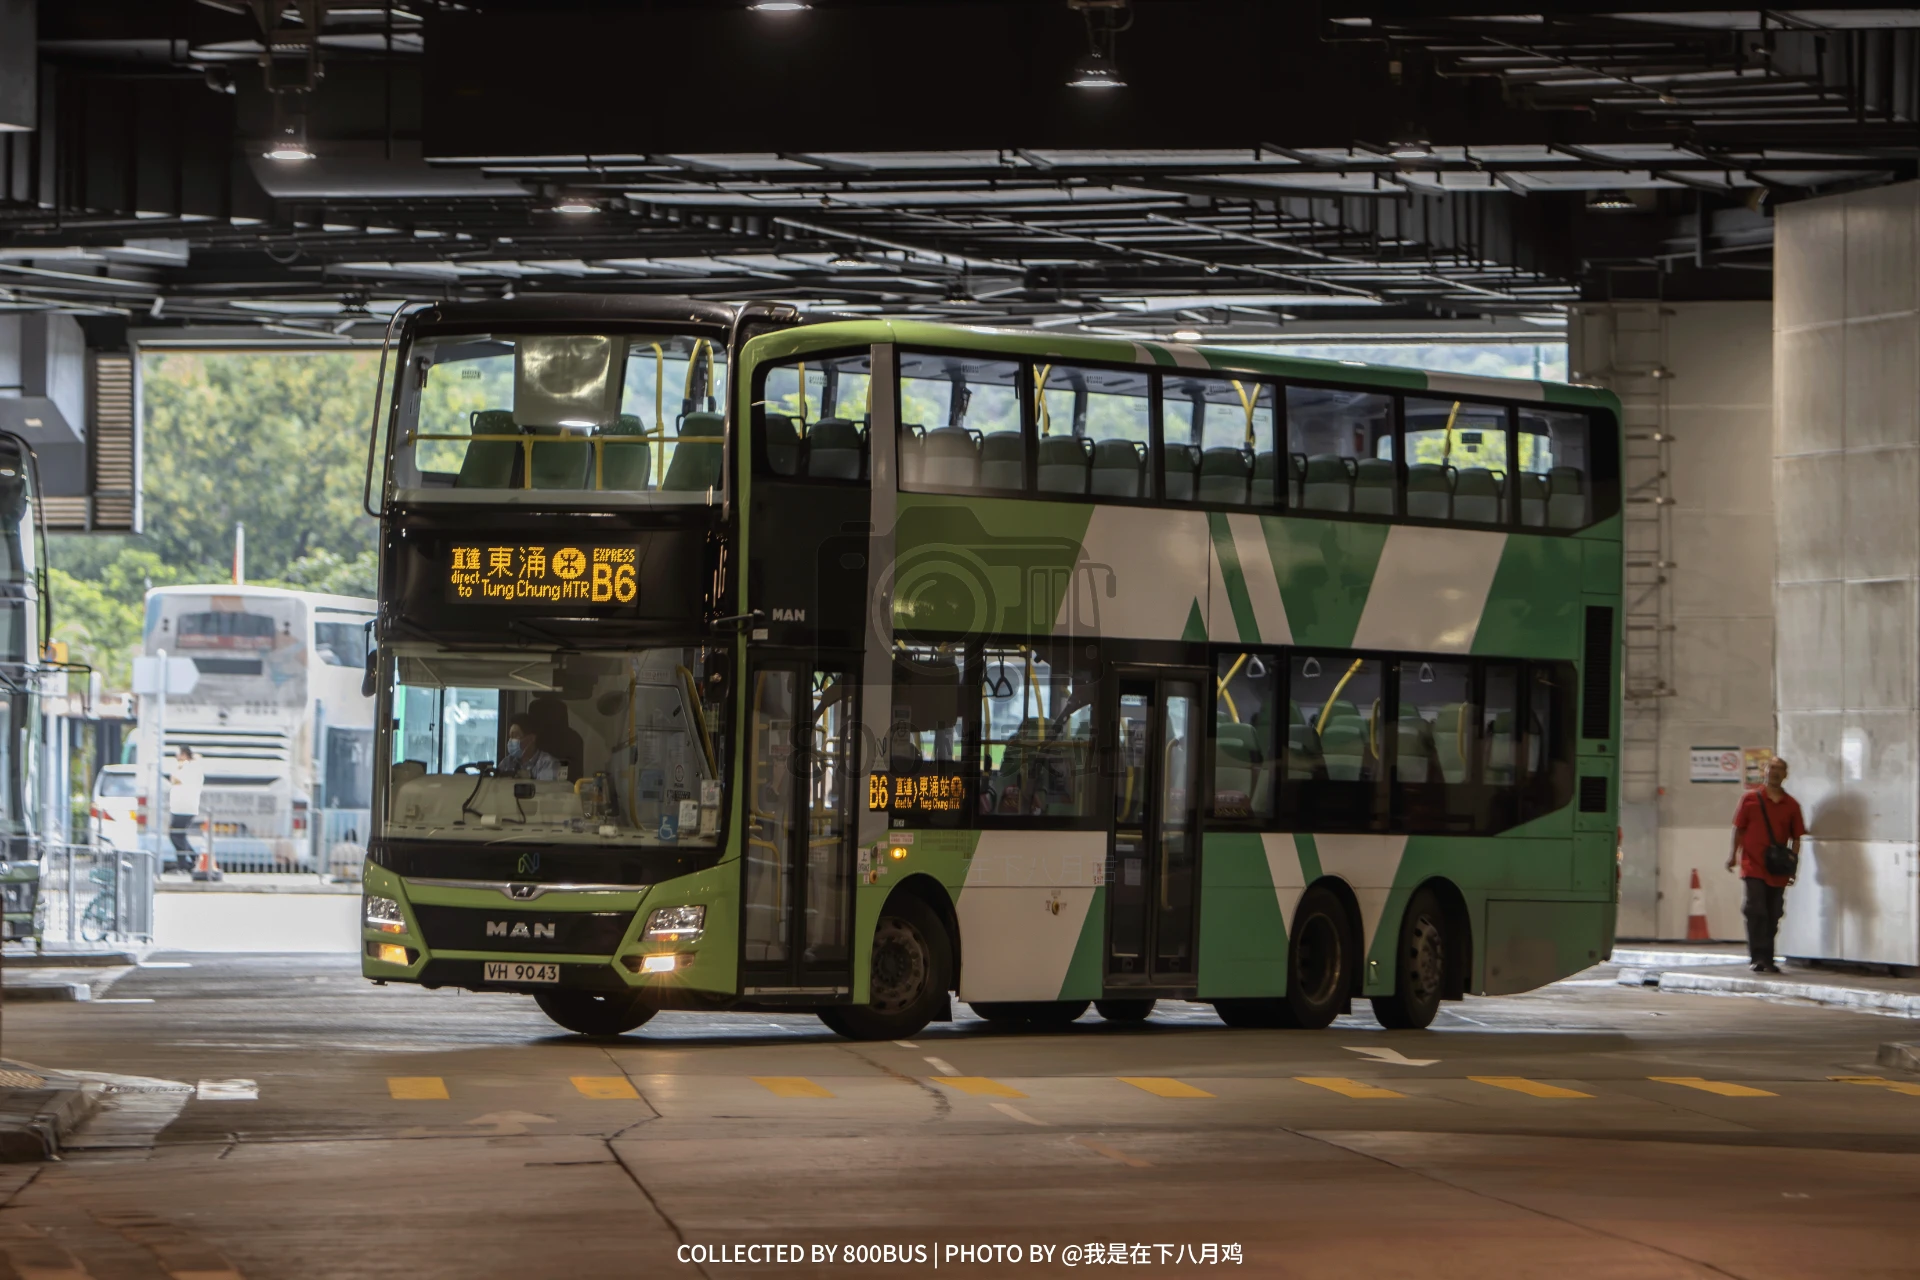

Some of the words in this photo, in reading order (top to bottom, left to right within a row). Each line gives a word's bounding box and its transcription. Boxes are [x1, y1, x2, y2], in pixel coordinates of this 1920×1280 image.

[451, 547, 481, 570] 直達
[486, 546, 546, 579] 東涌
[593, 548, 636, 563] EXPRESS
[451, 571, 480, 585] direct
[591, 563, 637, 602] B6
[458, 584, 473, 598] to
[481, 579, 514, 600] Tung
[516, 579, 560, 601] Chung
[562, 581, 590, 598] MTR
[773, 609, 805, 621] MAN
[869, 774, 889, 809] B6
[486, 921, 556, 938] MAN
[488, 964, 509, 979] VH
[515, 964, 558, 981] 9043
